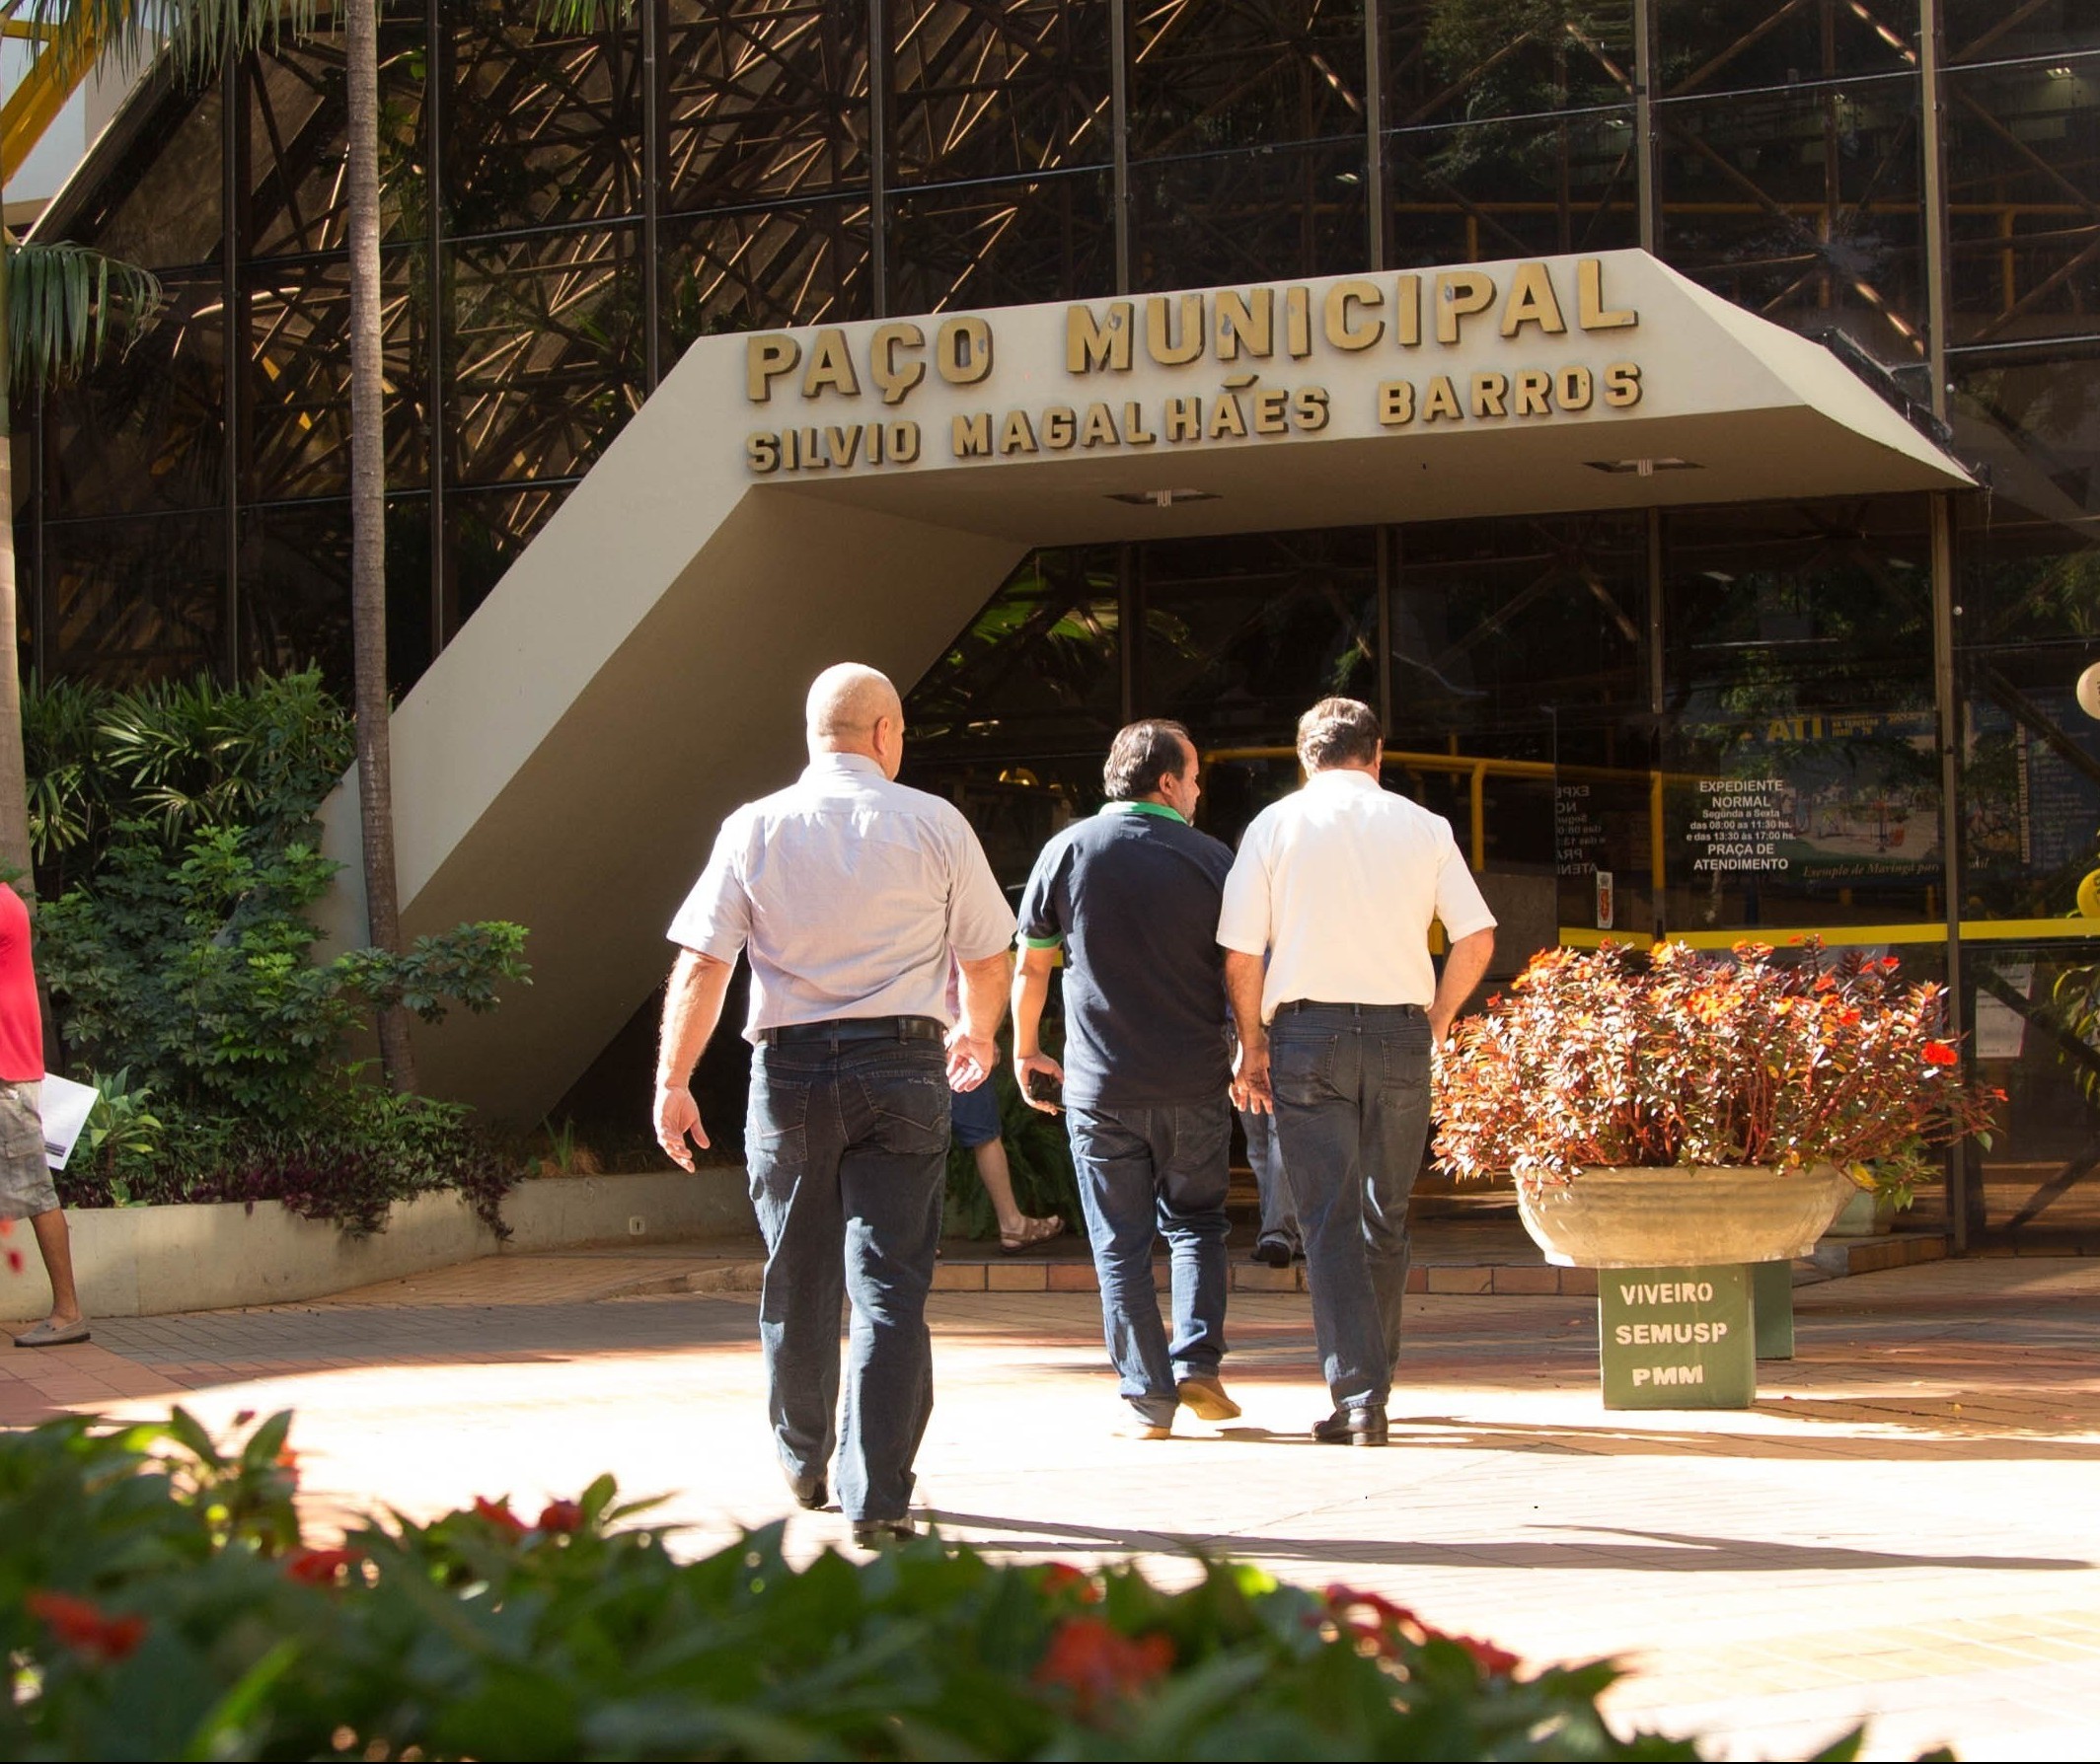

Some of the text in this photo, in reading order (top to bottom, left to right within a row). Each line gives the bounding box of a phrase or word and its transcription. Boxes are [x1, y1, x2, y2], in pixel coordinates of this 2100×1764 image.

[747, 258, 1638, 404] PAÇO MUNICIPAL
[747, 361, 1643, 474] SILVIO MAGALHÃES BARROS
[1767, 715, 1823, 741] ATI
[1699, 779, 1784, 792] EXPEDIENTE
[1711, 796, 1771, 808] NORMAL
[1702, 809, 1744, 820] Segunda
[1754, 809, 1780, 818] Sexta
[1709, 821, 1736, 830] 08:00
[1694, 833, 1711, 842] das
[1713, 833, 1740, 842] 13:30
[1756, 832, 1780, 841] 17:00
[1707, 843, 1774, 857] PRAÇA DE
[1693, 858, 1789, 870] ATENDIMENTO
[1620, 1283, 1713, 1305] VIVEIRO
[1615, 1322, 1727, 1345] SEMUSP
[1632, 1365, 1703, 1386] PMM
